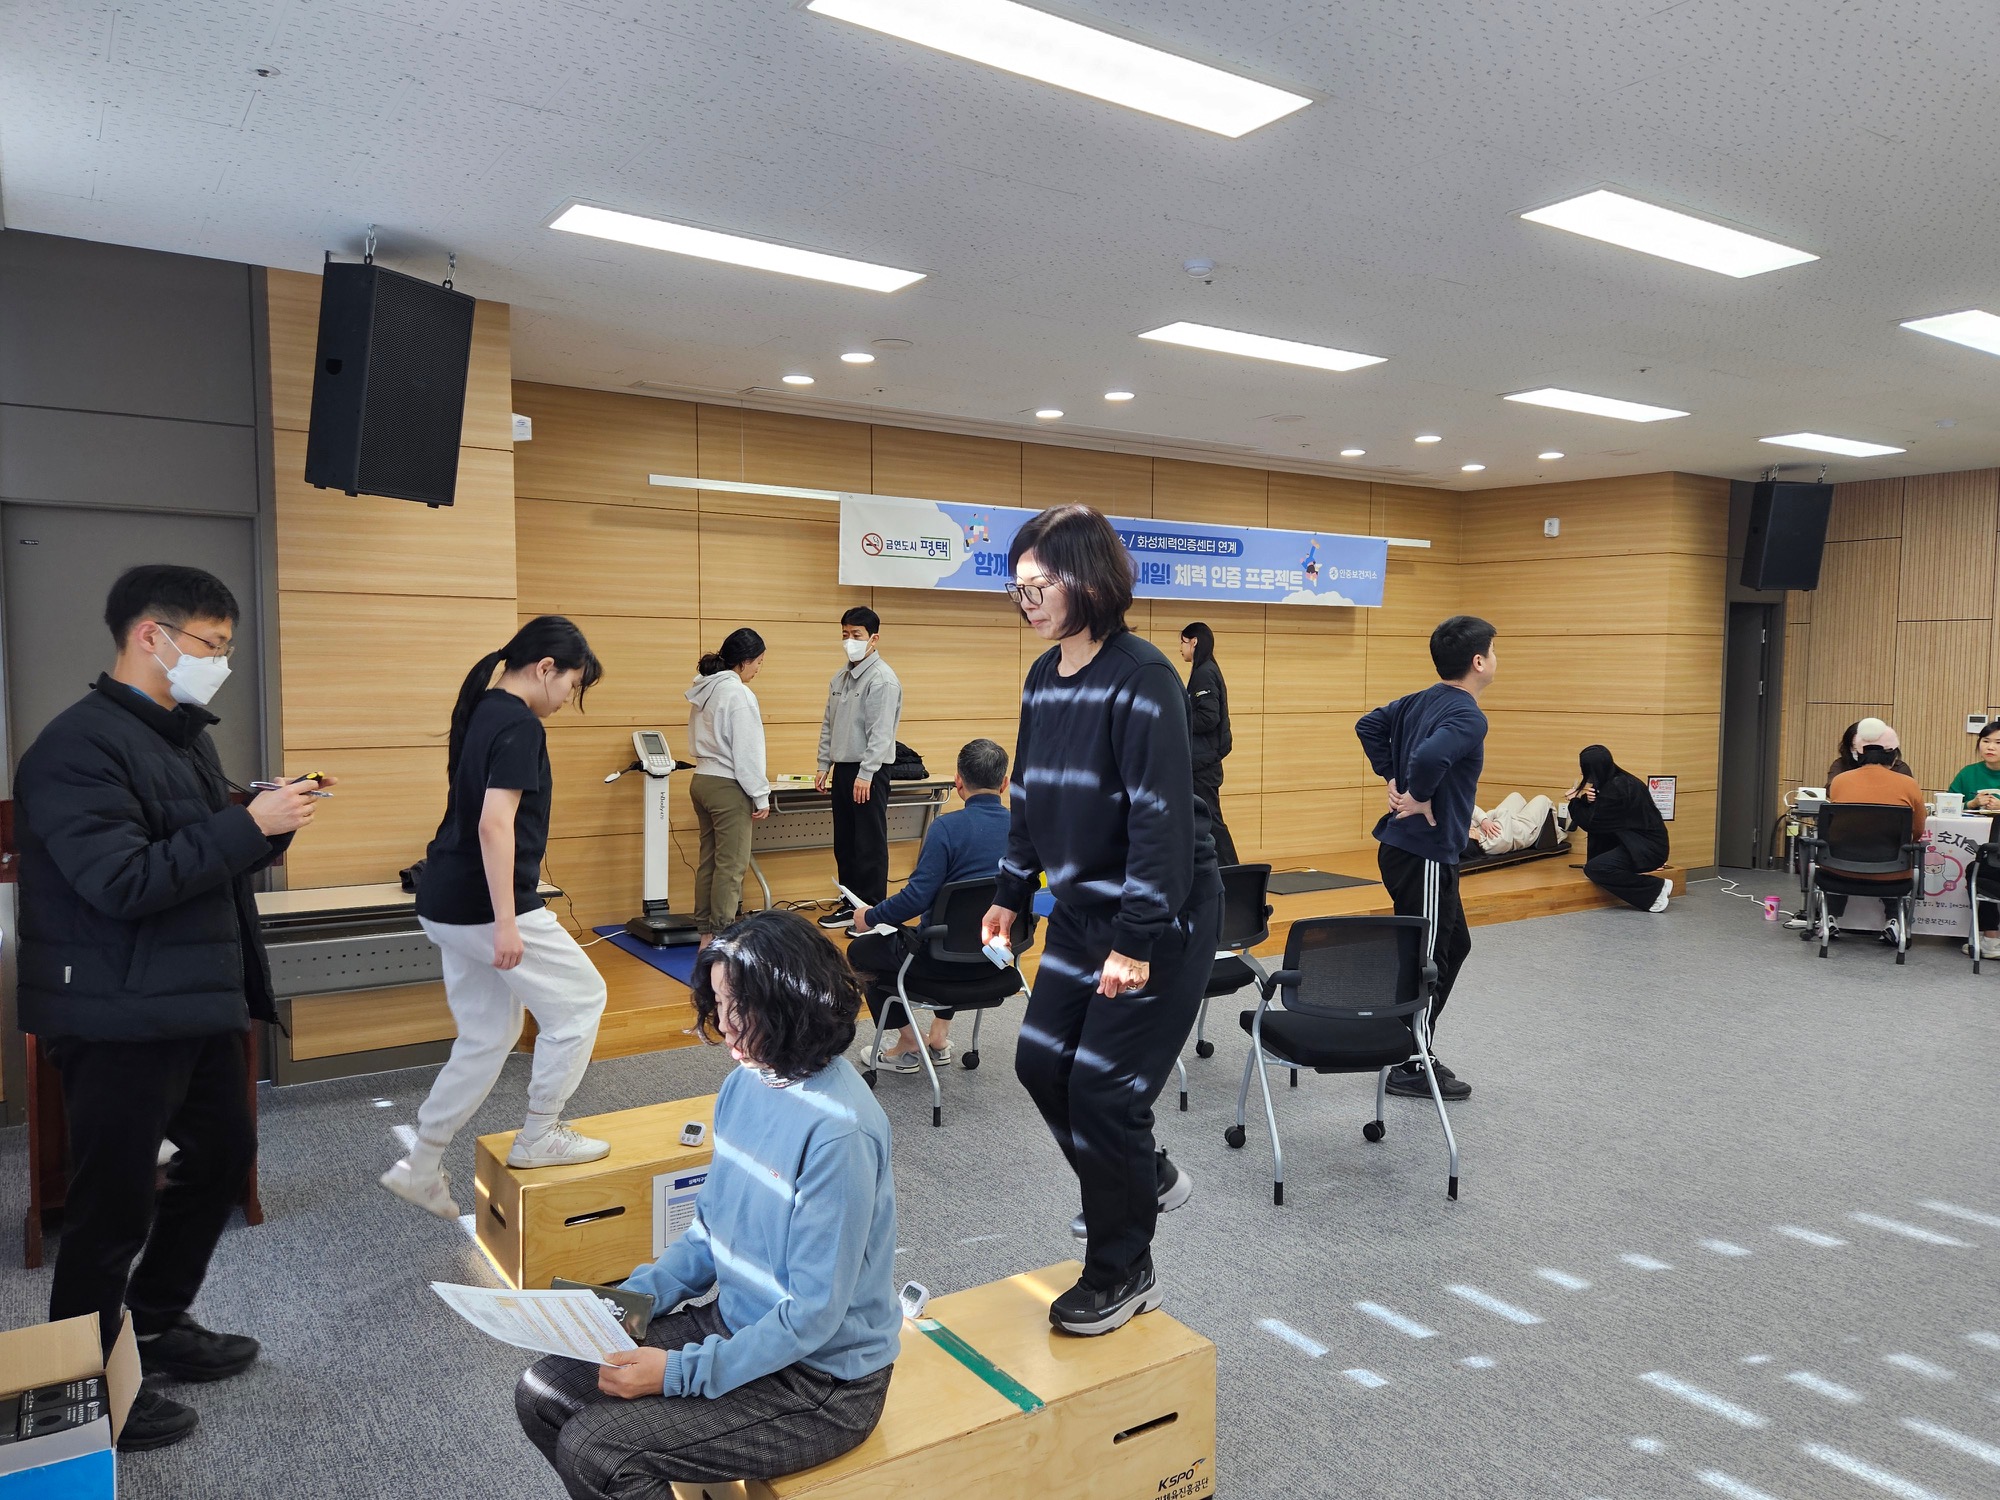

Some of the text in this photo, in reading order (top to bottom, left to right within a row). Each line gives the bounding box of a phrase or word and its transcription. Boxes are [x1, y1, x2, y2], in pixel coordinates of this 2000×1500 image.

[885, 539, 948, 557] 금연도시 평택
[1137, 535, 1216, 553] 화성체력인증센터
[1218, 540, 1237, 554] 연계
[1174, 563, 1207, 587] 체력
[1211, 566, 1242, 589] 인증
[1245, 568, 1304, 591] 프로젝트
[1157, 1468, 1194, 1492] KSPO
